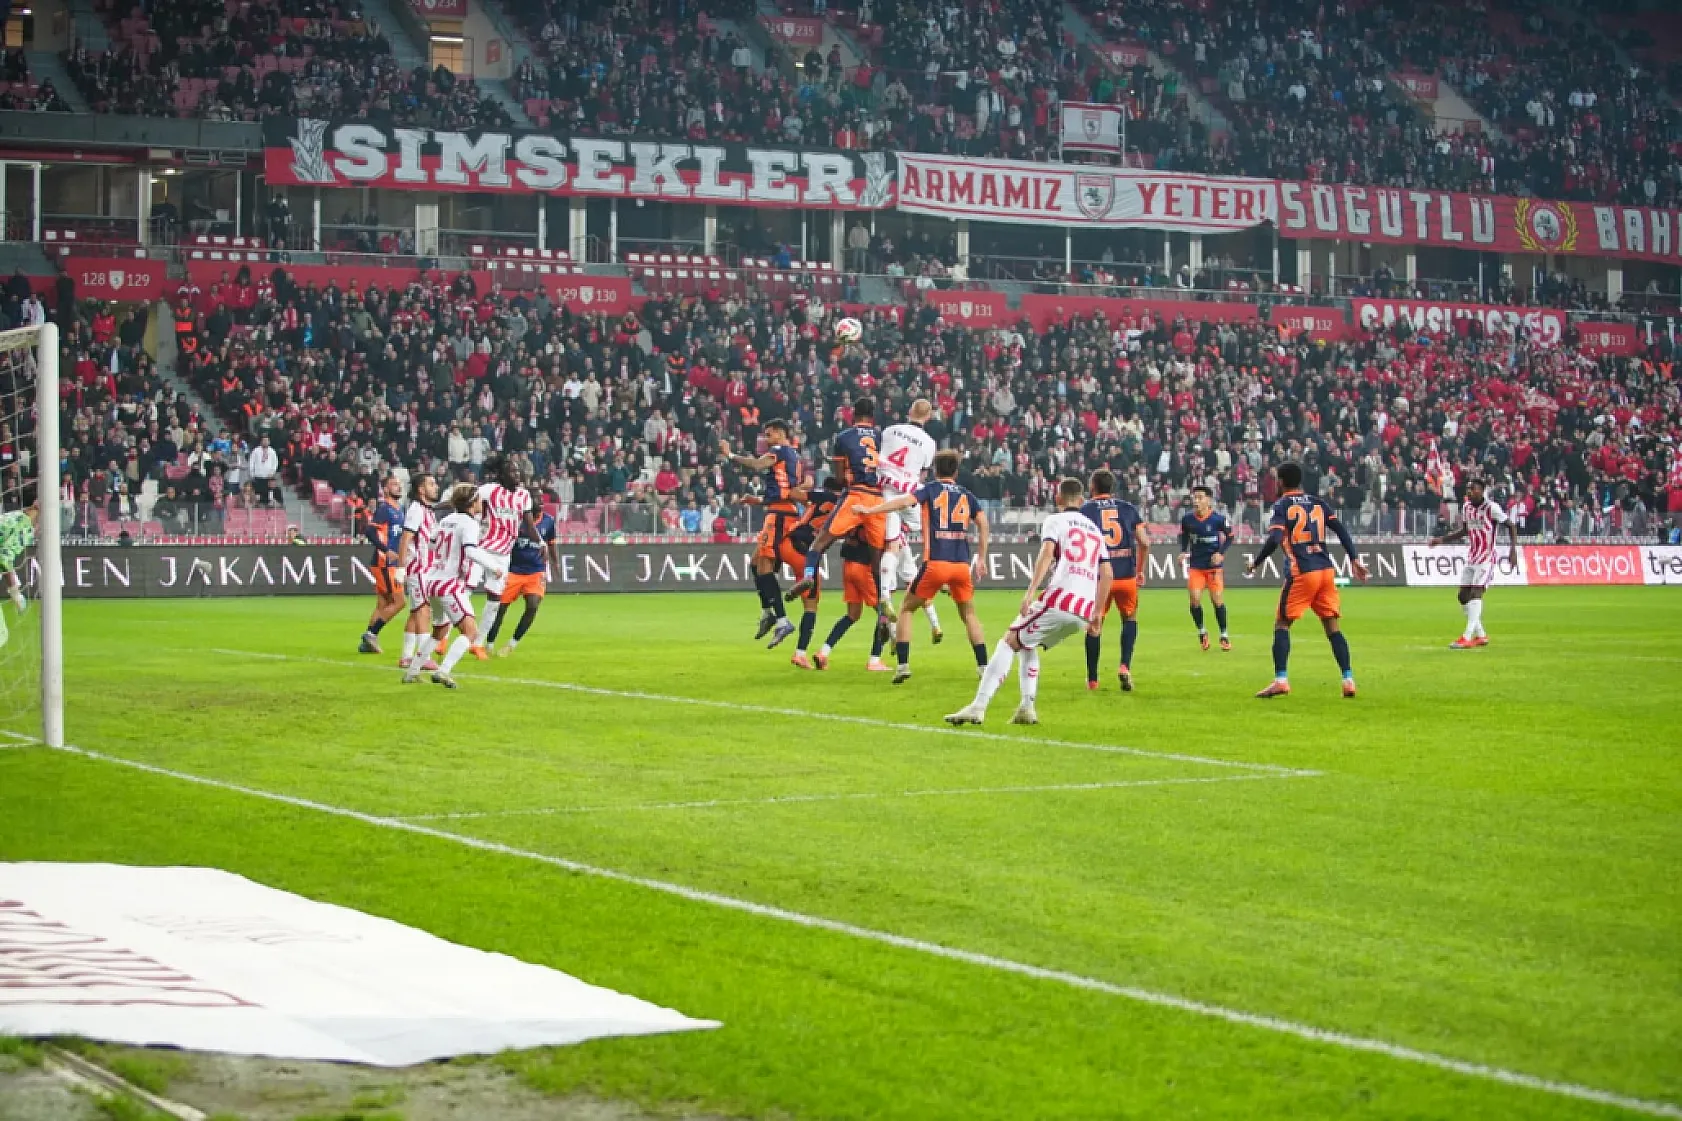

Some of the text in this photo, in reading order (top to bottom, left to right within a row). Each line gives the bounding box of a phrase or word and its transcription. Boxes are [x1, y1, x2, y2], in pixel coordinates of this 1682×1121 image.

[902, 164, 1268, 220] ARMAMIZ YETER!
[1594, 206, 1682, 256] BAH
[82, 272, 150, 287] 128 129
[596, 289, 617, 302] 130
[887, 446, 909, 468] 4
[933, 490, 970, 530] 14
[1101, 509, 1122, 547] 5
[1288, 505, 1325, 544] 21
[1065, 528, 1101, 568] 37
[1534, 549, 1636, 581] trendyol
